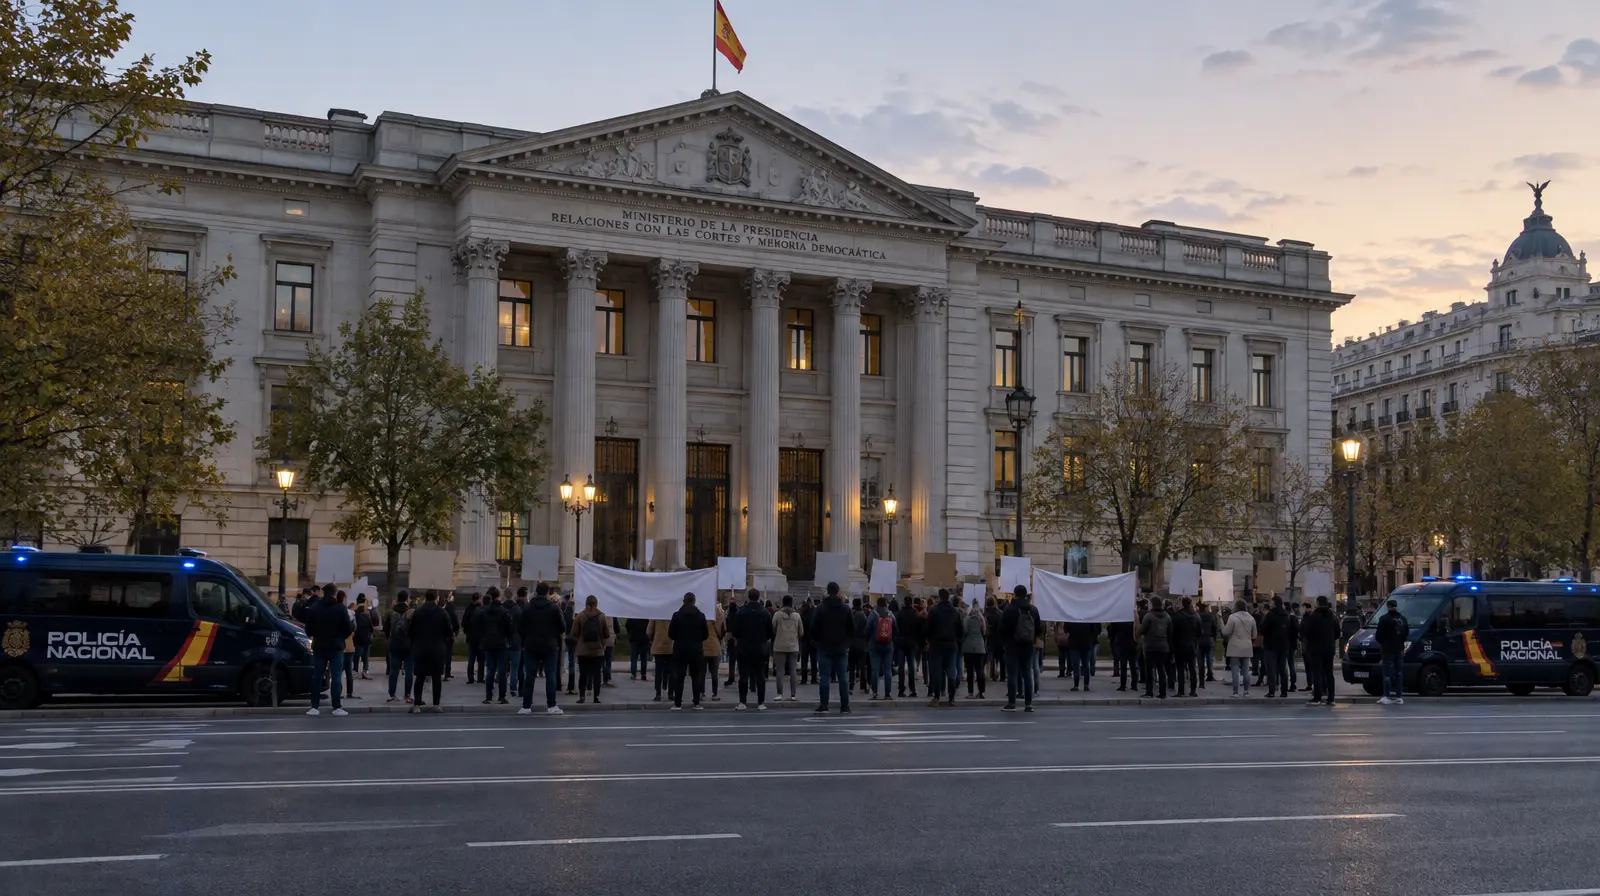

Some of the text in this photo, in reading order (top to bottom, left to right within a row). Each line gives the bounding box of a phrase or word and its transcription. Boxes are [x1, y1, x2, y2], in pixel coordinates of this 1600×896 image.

[551, 212, 629, 230] RELACIONES
[635, 222, 661, 234] CON
[667, 226, 689, 237] LAS
[695, 229, 741, 243] CORTES
[746, 236, 754, 244] Y
[622, 210, 819, 242] MINISTERIO DE LA PRESIDENCIA
[47, 629, 141, 646] POLICÍA
[1500, 638, 1553, 650] POLICÍA
[46, 646, 155, 660] NACIONAL
[1500, 650, 1562, 660] NACIONAL
